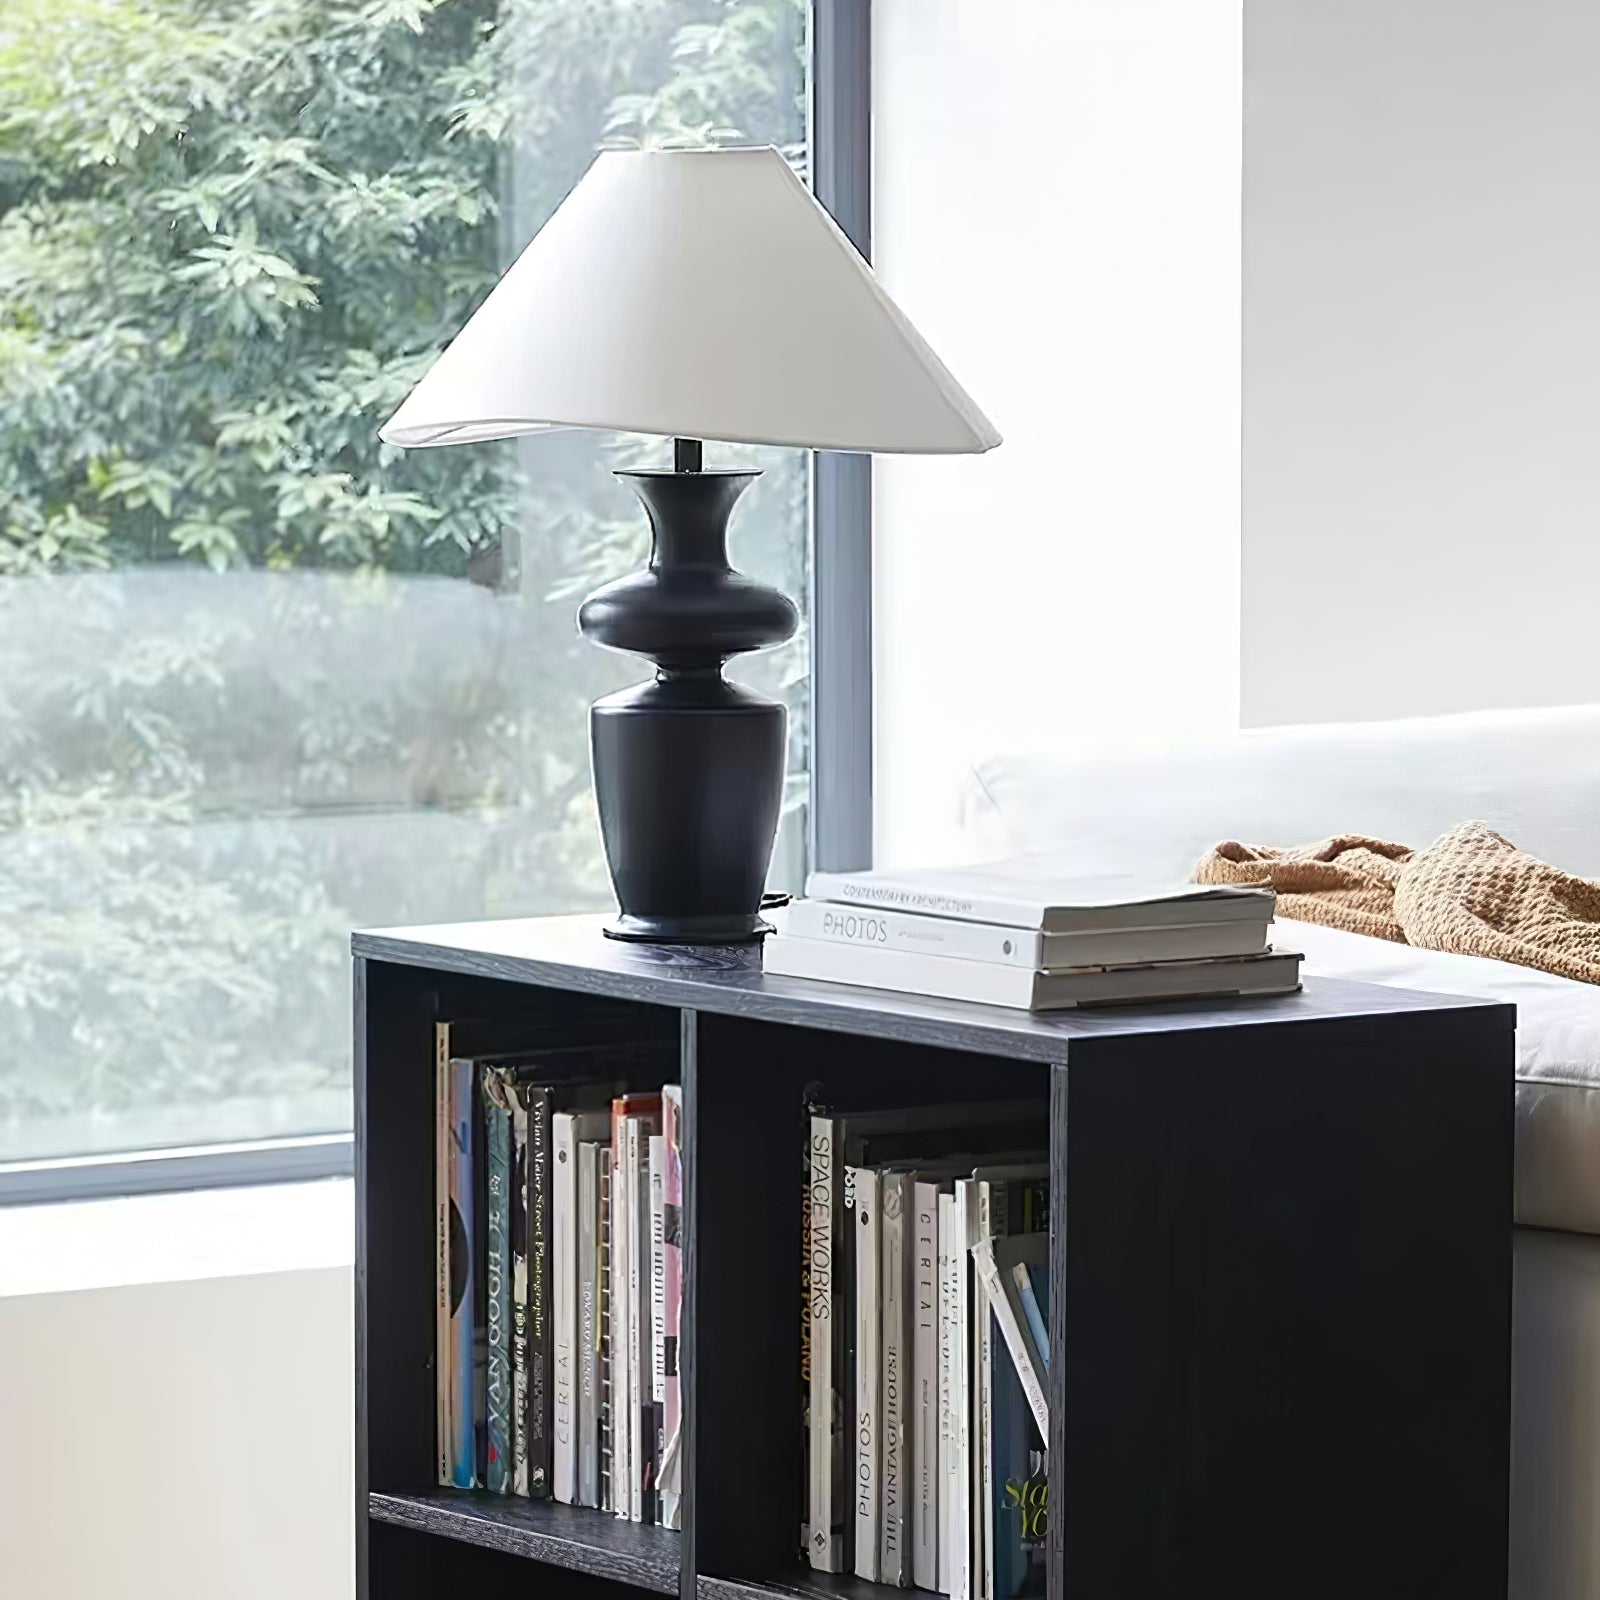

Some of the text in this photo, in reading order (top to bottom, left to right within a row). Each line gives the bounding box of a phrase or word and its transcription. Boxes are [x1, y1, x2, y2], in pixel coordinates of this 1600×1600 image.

[823, 912, 888, 942] PHOTOS
[812, 1134, 830, 1320] SPACE WORKS
[558, 1343, 570, 1445] CEREAL
[858, 1411, 872, 1518] PHOTOS
